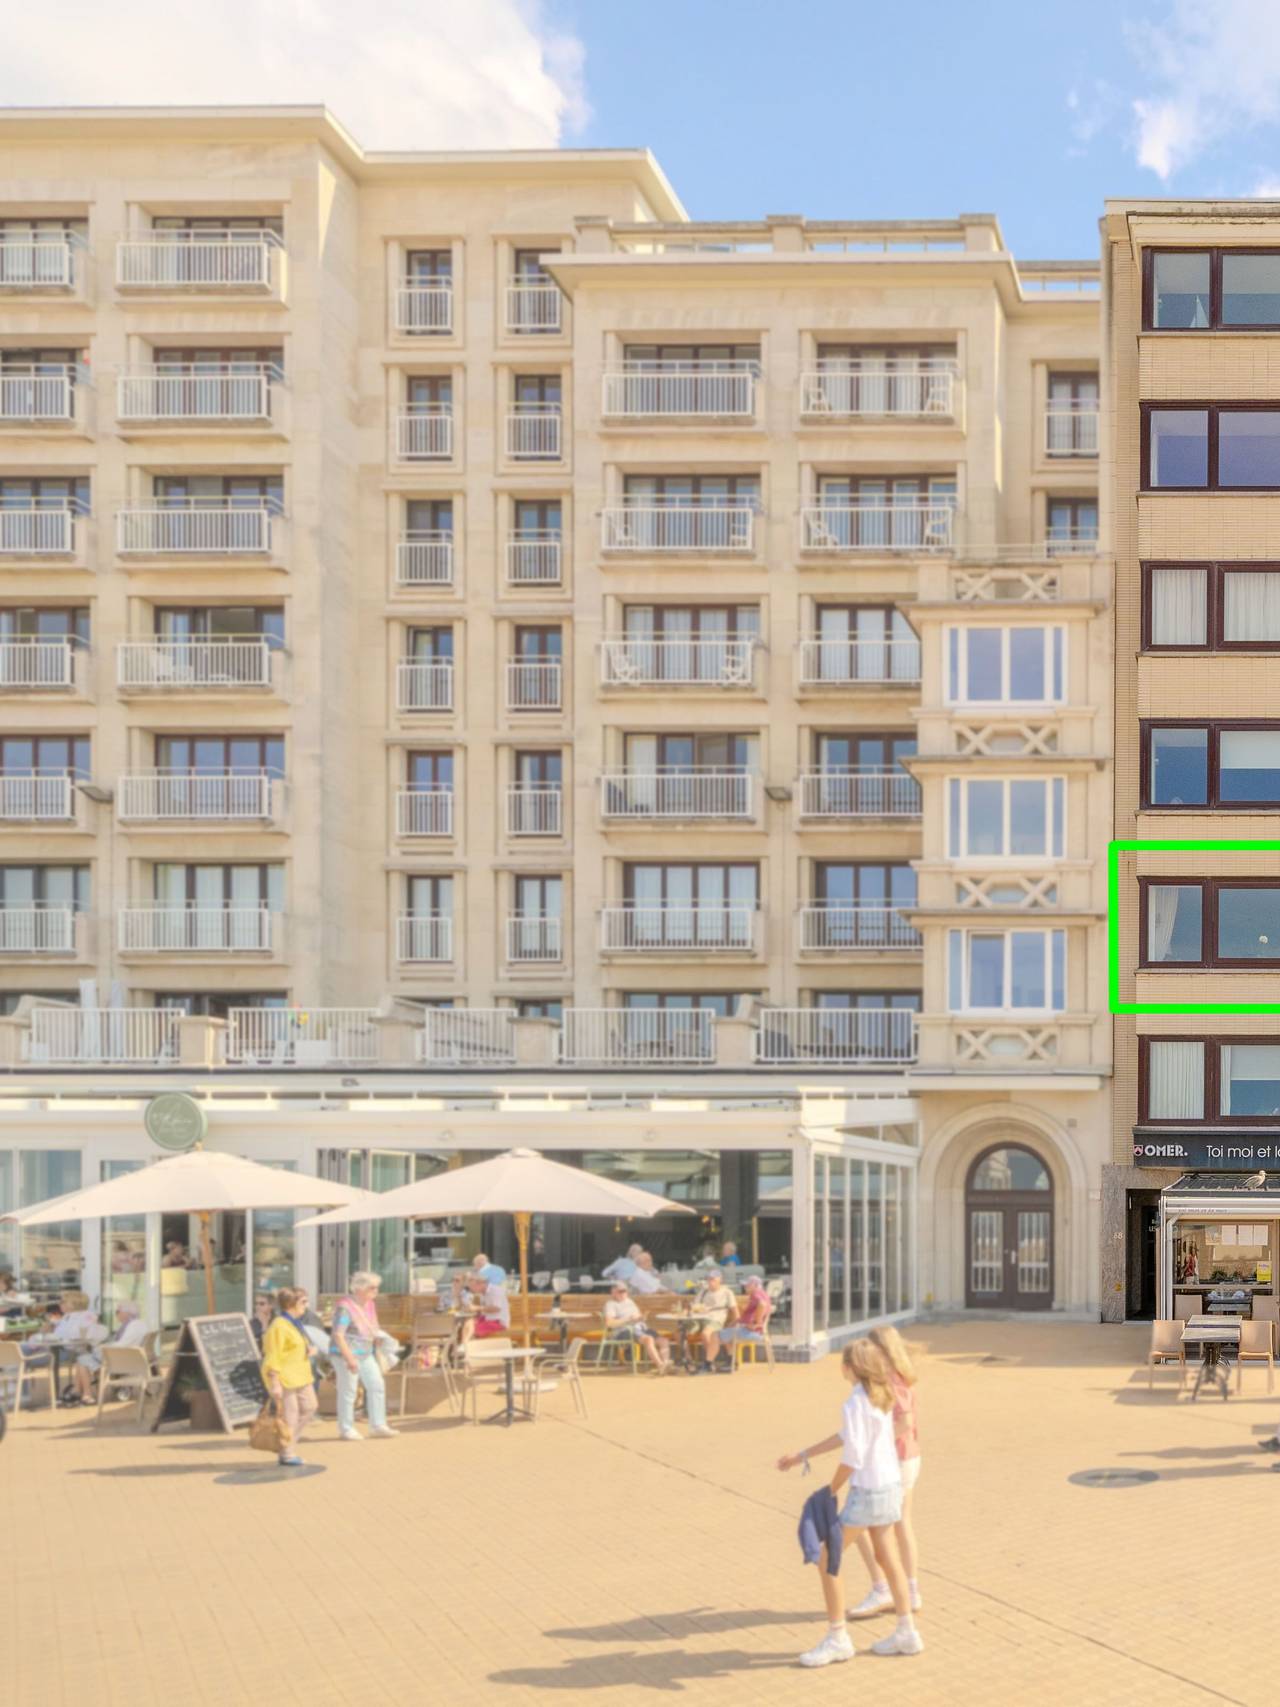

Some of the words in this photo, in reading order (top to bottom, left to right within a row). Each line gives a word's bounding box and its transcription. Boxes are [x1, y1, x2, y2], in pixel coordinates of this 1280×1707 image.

[1144, 1144, 1189, 1157] OMER.
[1206, 1145, 1224, 1158] Toi
[1227, 1145, 1254, 1158] moi
[1257, 1145, 1272, 1158] et
